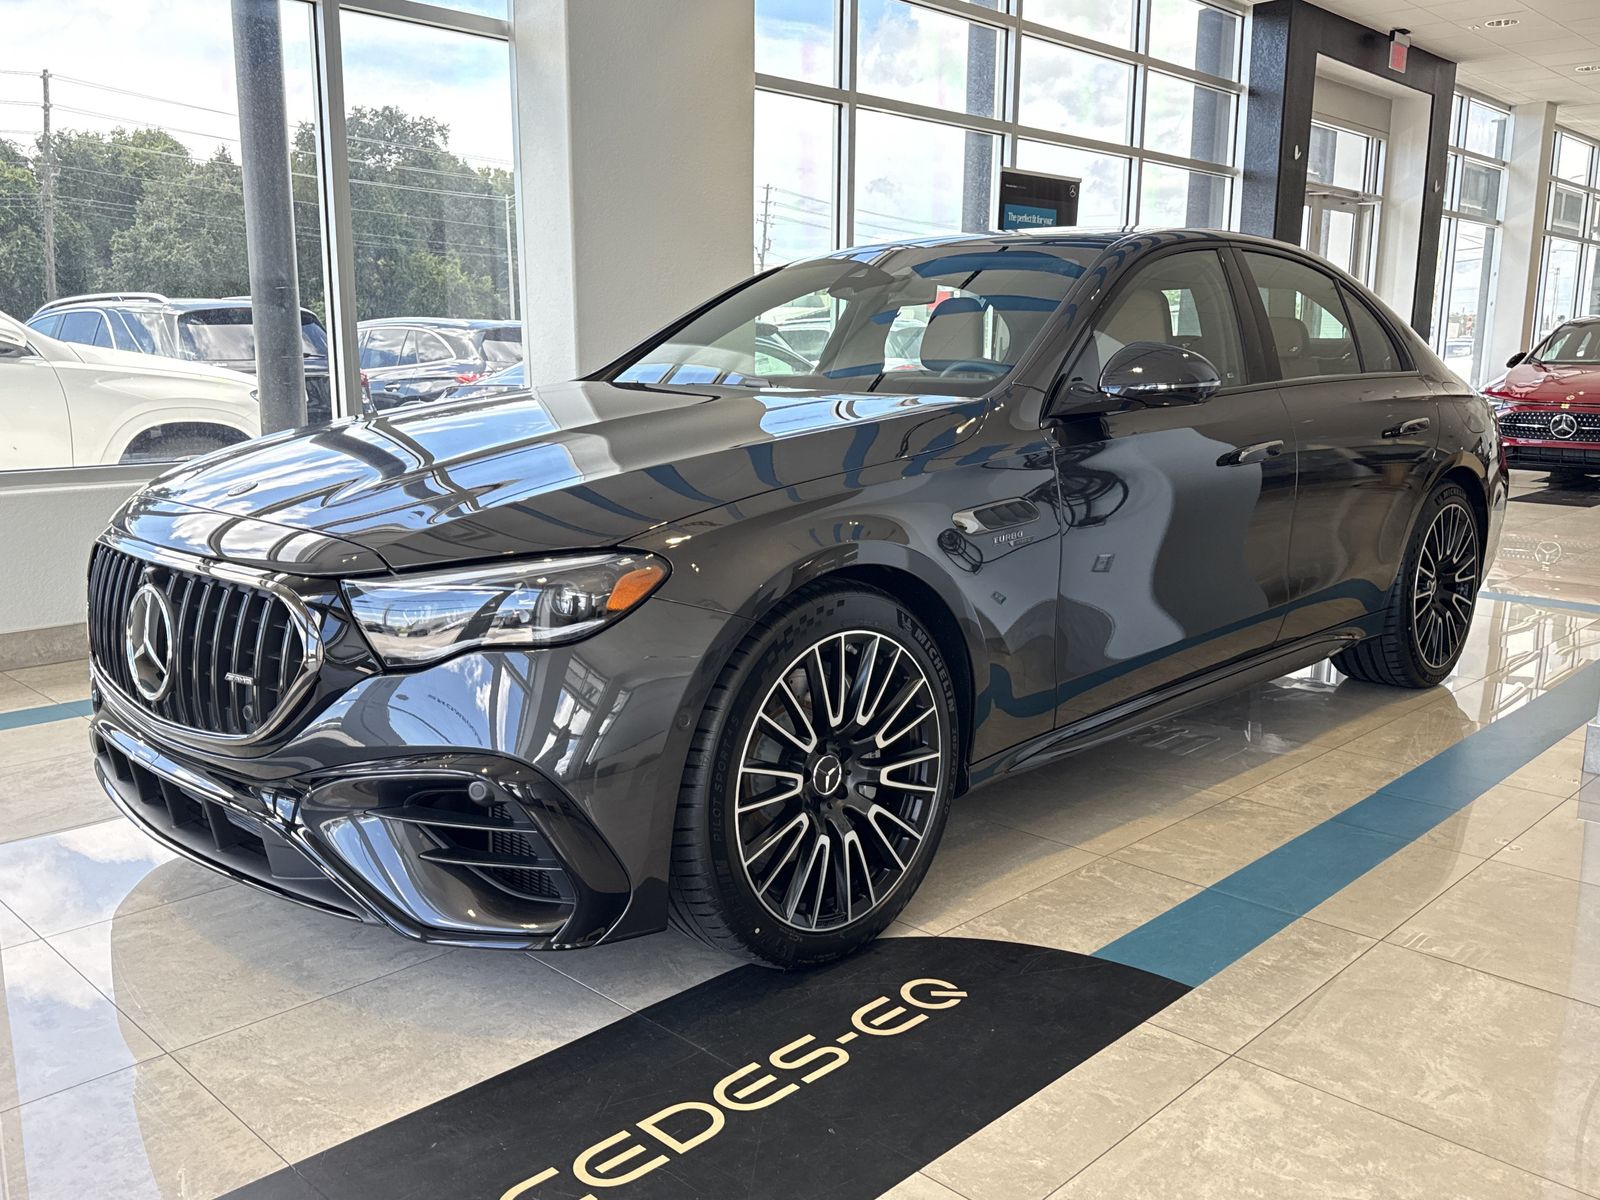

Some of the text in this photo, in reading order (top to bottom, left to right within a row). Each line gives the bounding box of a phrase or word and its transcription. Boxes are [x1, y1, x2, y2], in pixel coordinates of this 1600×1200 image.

[1008, 212, 1016, 222] The
[994, 531, 1023, 544] TURBO
[914, 628, 955, 712] MICHELIN
[714, 740, 731, 793] SPORT
[712, 797, 722, 842] PILOT
